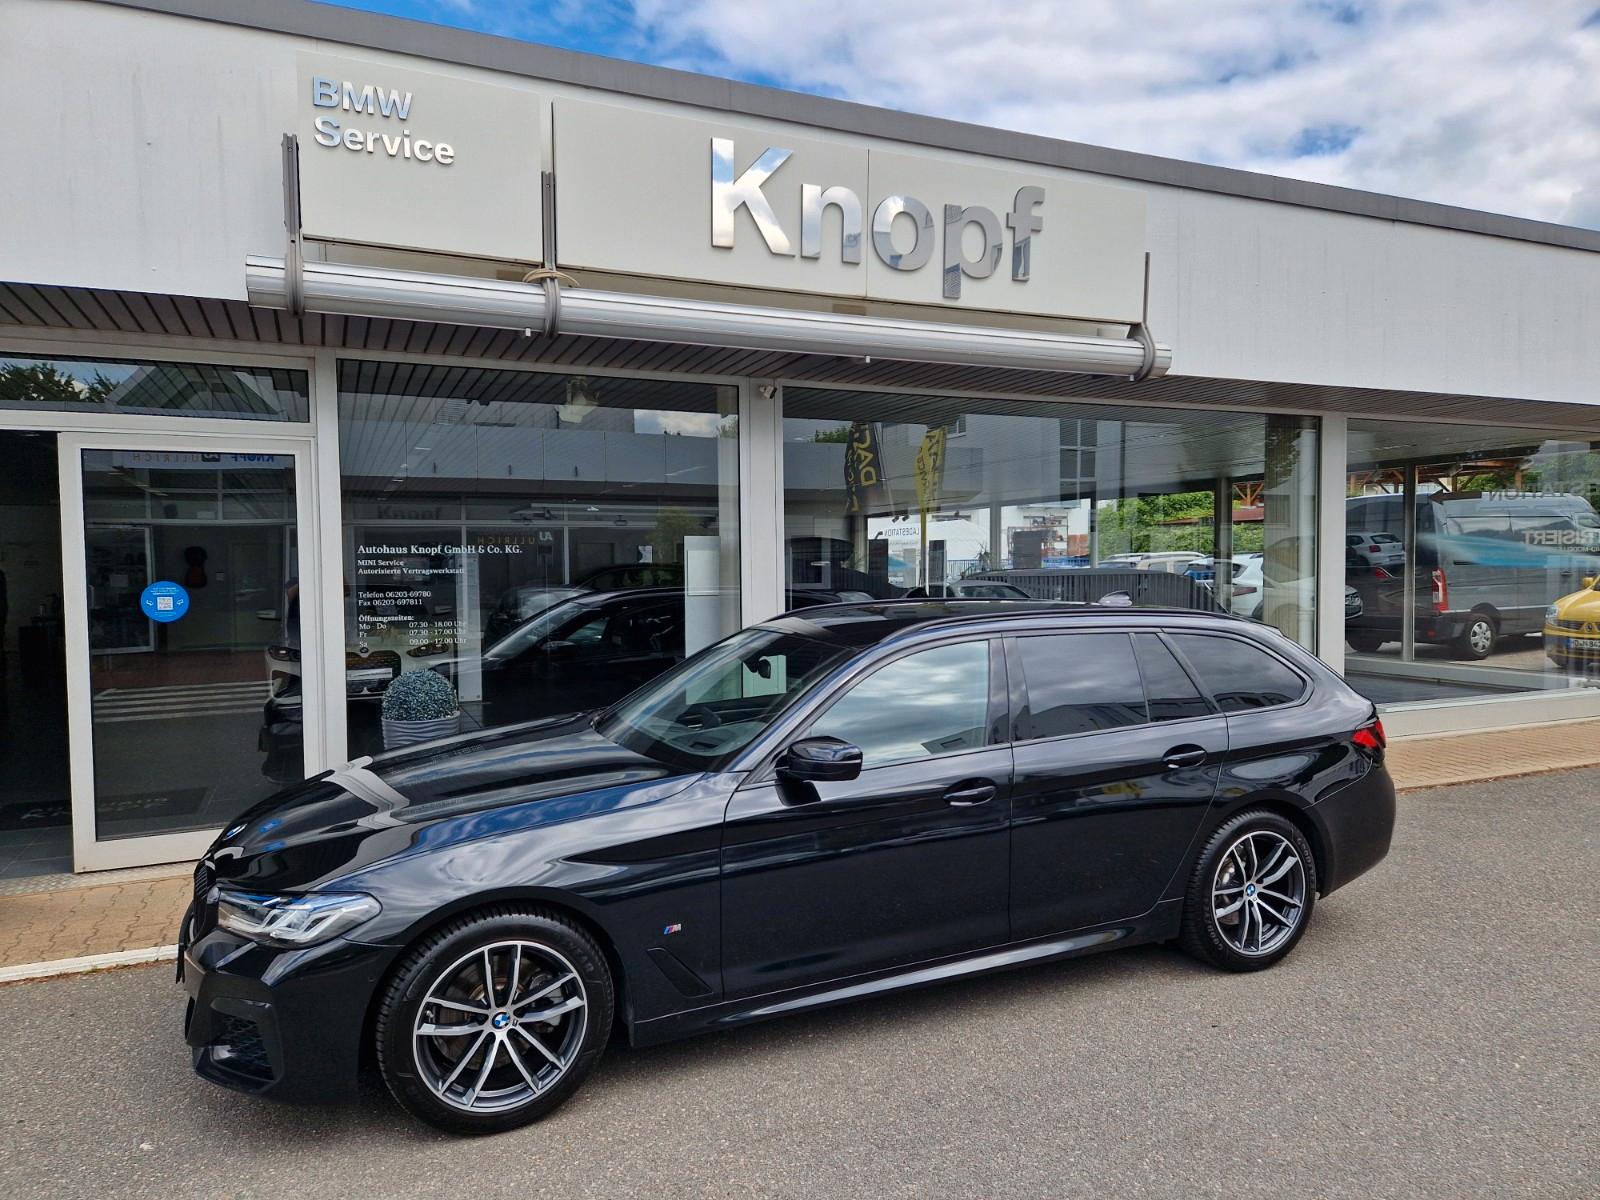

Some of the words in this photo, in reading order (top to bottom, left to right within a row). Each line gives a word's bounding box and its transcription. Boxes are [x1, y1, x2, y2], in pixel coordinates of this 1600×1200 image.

[313, 75, 413, 120] BMW
[314, 115, 455, 165] Service
[710, 136, 1046, 299] Knopf
[357, 545, 408, 554] Autohaus
[411, 544, 441, 556] Knopf
[444, 545, 476, 554] GmbH
[478, 545, 484, 554] &
[487, 545, 503, 554] Co.
[505, 545, 523, 554] KG.
[357, 567, 401, 575] Autorisierte
[386, 590, 431, 598] 06203-69780
[372, 598, 423, 606] 06203-697811
[376, 622, 387, 630] Do
